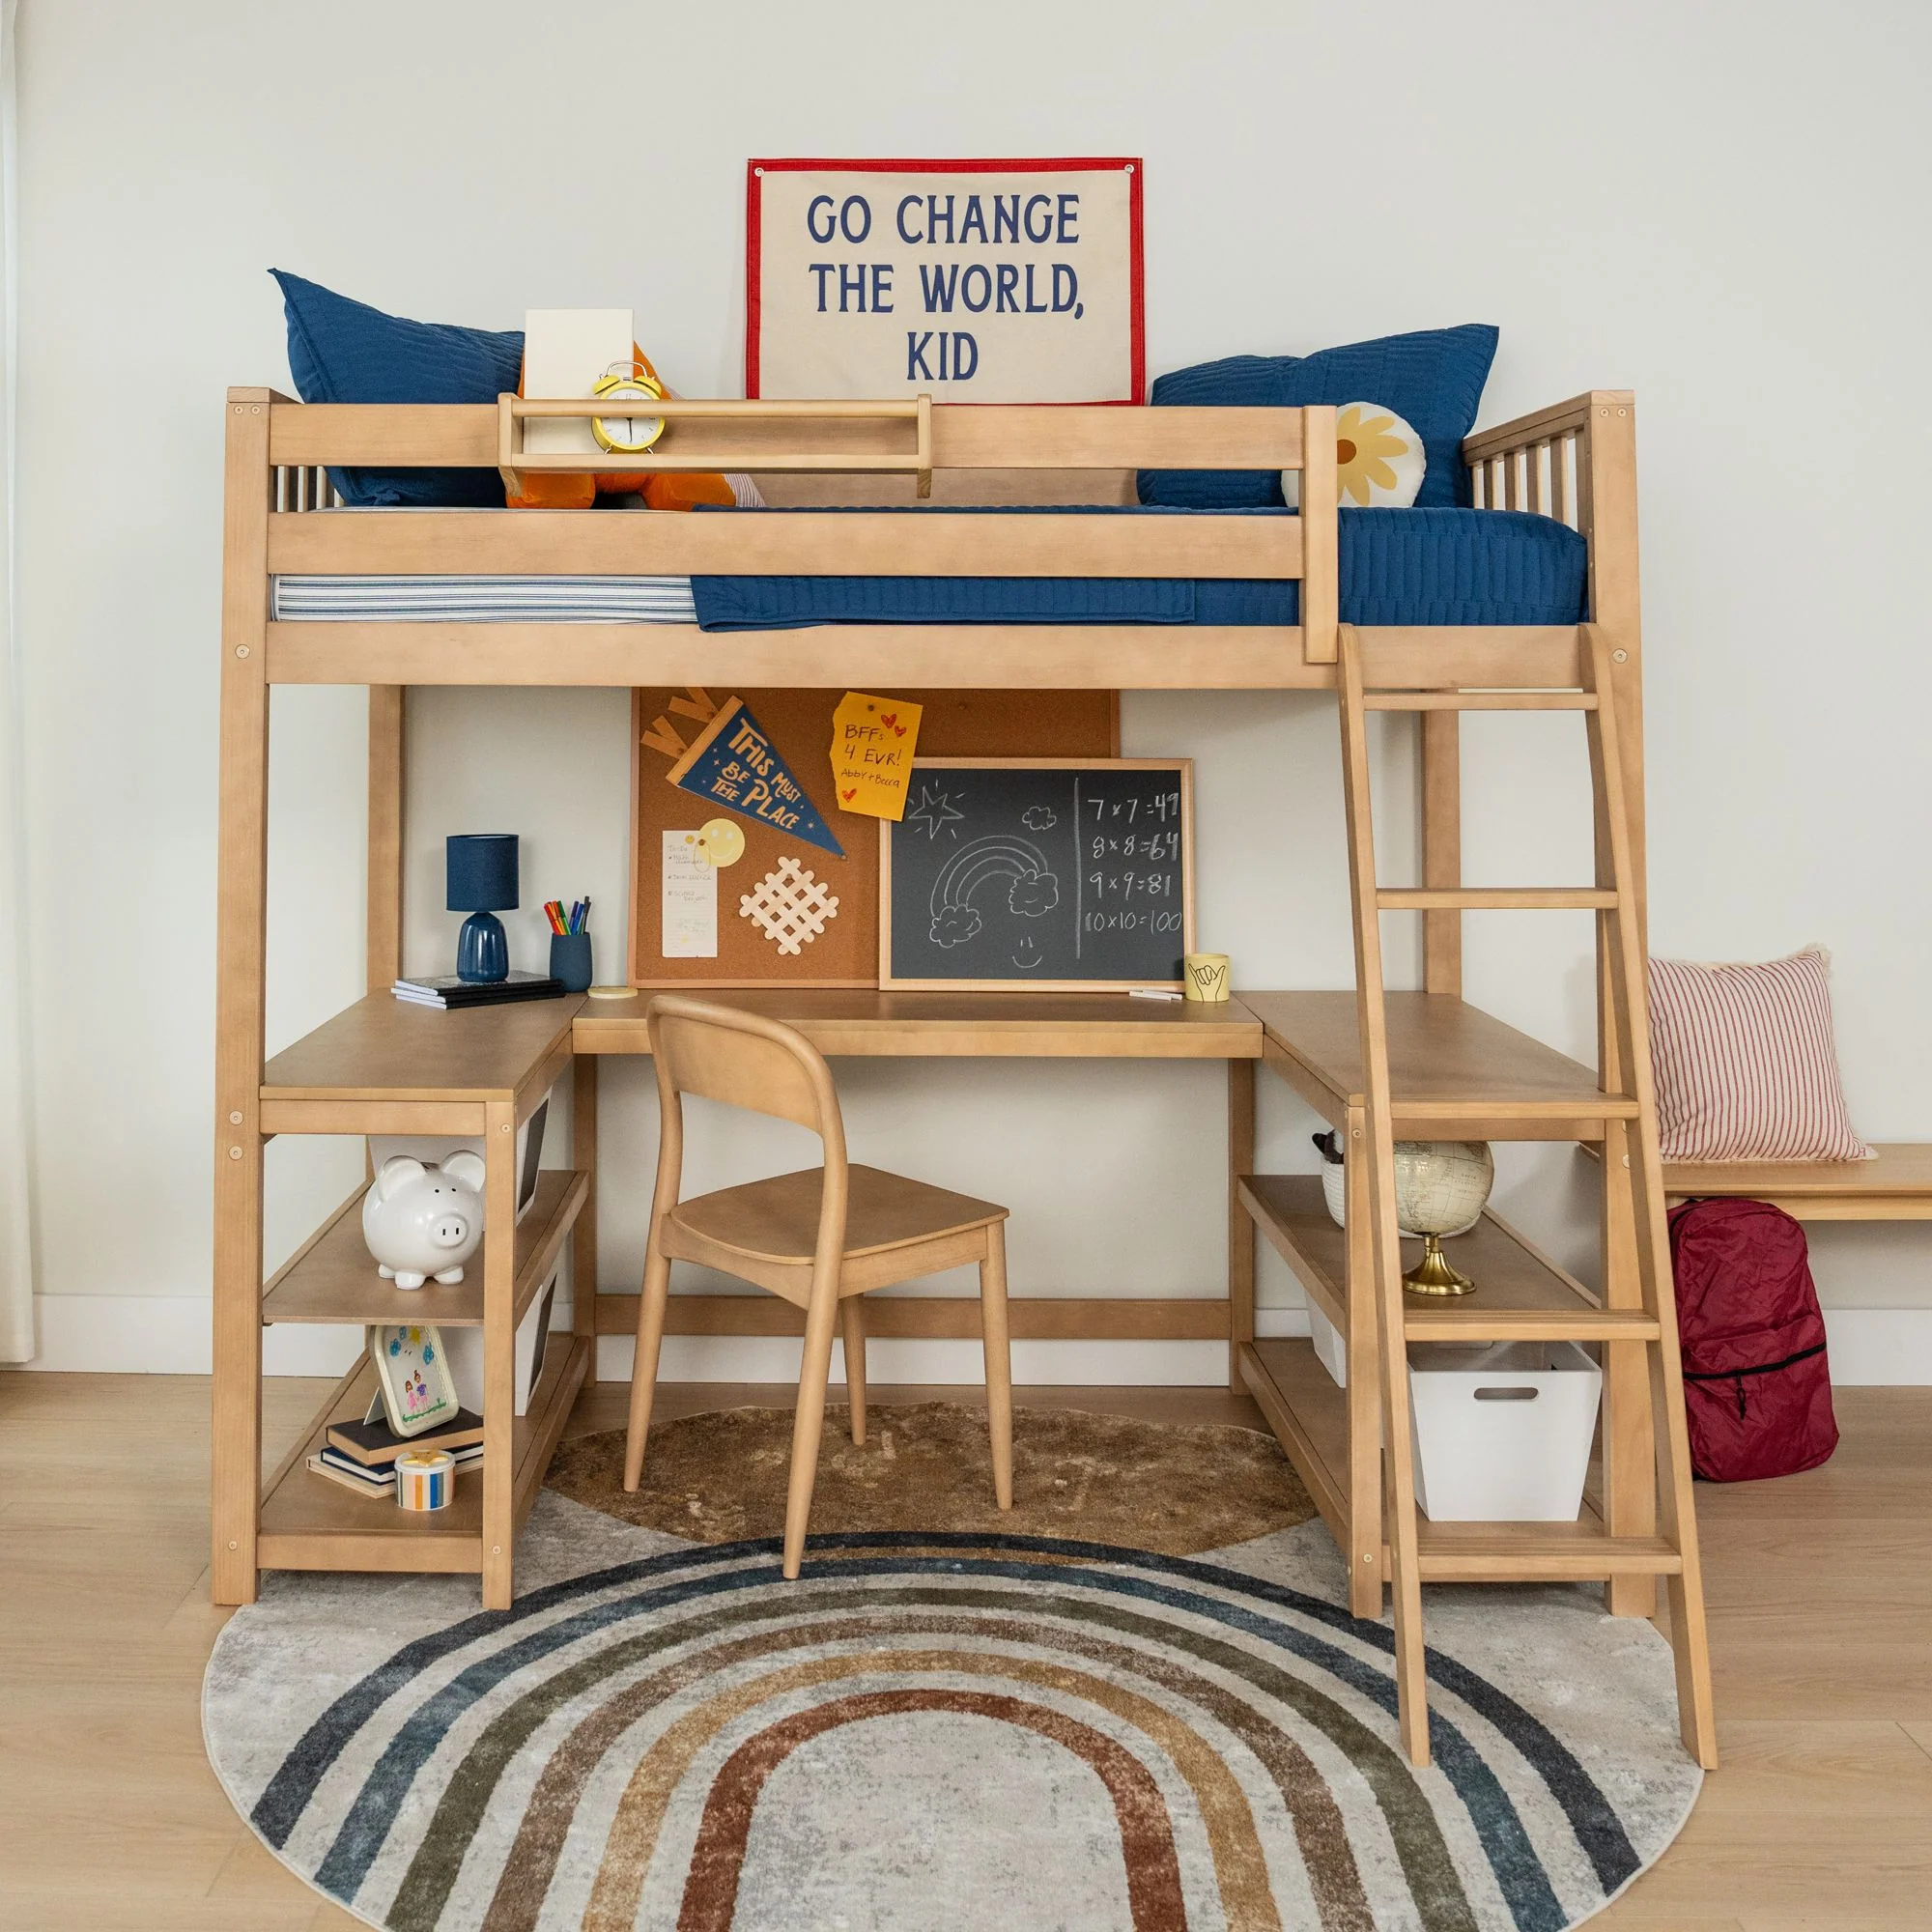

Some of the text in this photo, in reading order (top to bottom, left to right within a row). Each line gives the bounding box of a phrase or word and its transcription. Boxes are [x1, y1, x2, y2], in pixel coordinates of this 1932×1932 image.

[808, 194, 1080, 244] GO CHANGE
[809, 264, 1084, 320] THE WORLD,
[906, 331, 979, 381] KID
[722, 760, 751, 783] BE
[727, 717, 802, 804] THIS MUST
[844, 743, 902, 766] 4 EVR!
[710, 776, 741, 802] THE
[741, 779, 801, 830] PLACE
